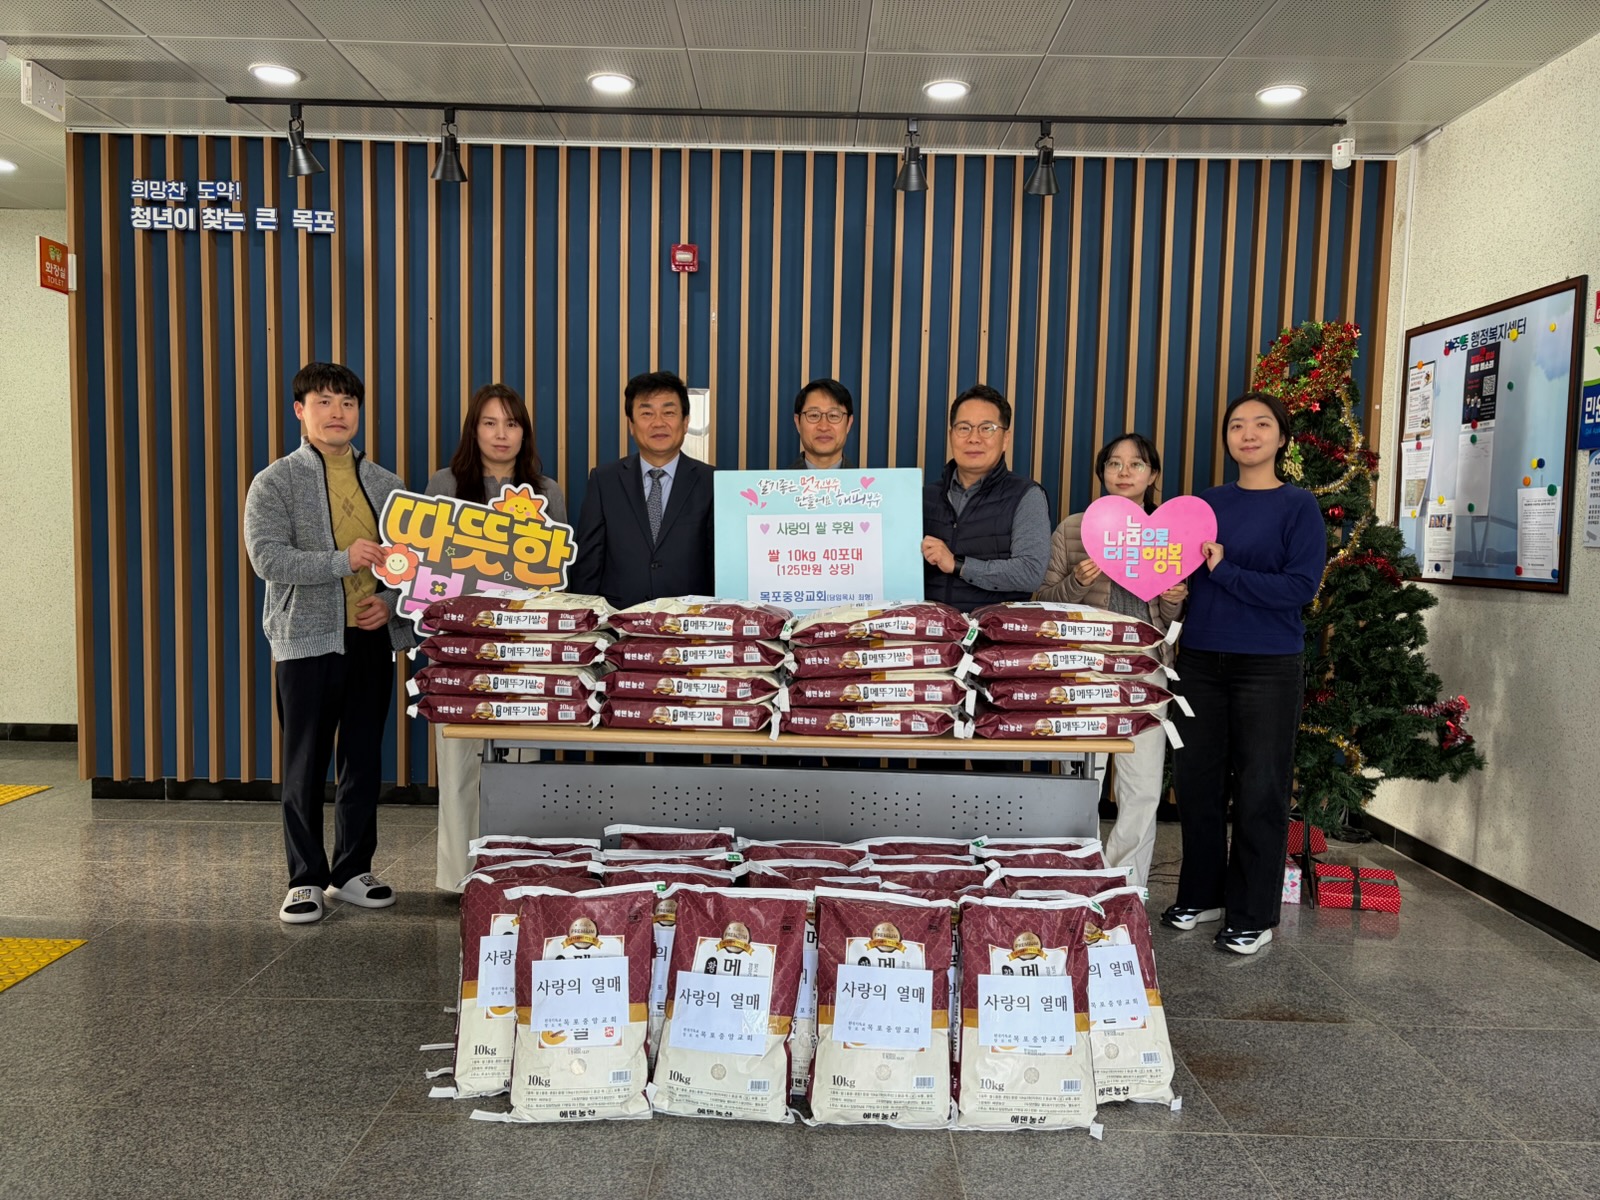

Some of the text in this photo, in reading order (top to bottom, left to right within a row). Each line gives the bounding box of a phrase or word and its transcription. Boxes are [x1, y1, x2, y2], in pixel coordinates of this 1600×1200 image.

[131, 180, 241, 201] 희망찬 도약!
[131, 207, 336, 233] 청년이 찾는 큰 목포
[45, 262, 66, 279] 화장실
[47, 276, 64, 287] TOILET
[1471, 317, 1527, 347] 행정복지센터
[758, 478, 798, 495] 살기좋은
[795, 495, 832, 509] 만들어요
[777, 521, 854, 536] 사랑의 쌀 후원
[1104, 515, 1169, 546] 나눔으로
[387, 496, 571, 585] 따뜻한
[768, 548, 863, 562] 쌀 10kg 40포대
[1142, 543, 1182, 575] 행복
[690, 620, 727, 632] 메뚜기쌀
[1067, 625, 1106, 637] 메뚜기쌀
[507, 645, 545, 657] 메뚜기쌀
[689, 649, 727, 660] 메뚜기쌀
[868, 652, 908, 663] 메뚜기쌀
[499, 678, 538, 690] 메뚜기쌀
[683, 682, 721, 694] 메뚜기쌀
[869, 687, 908, 698] 메뚜기쌀
[1076, 688, 1113, 698] 메뚜기쌀
[502, 705, 540, 717] 메뚜기쌀
[679, 710, 716, 722] 메뚜기쌀
[855, 716, 895, 727] 메뚜기쌀
[1062, 721, 1100, 732] 메뚜기쌀
[484, 950, 515, 966] 사랑
[1109, 960, 1135, 977] 열매
[536, 976, 621, 996] 사랑의 열매
[842, 981, 925, 1004] 사랑의 열매
[679, 988, 720, 1009] 사랑의
[730, 993, 760, 1011] 열매
[984, 994, 1068, 1013] 사랑의 열매
[473, 1044, 497, 1056] 10kg
[527, 1074, 551, 1088] 10kg
[669, 1069, 691, 1085] 10kg
[832, 1075, 856, 1089] 10kg
[979, 1078, 1005, 1092] 10kg
[1098, 1086, 1130, 1096] 에덴농산
[559, 1109, 597, 1119] 에덴농산
[697, 1107, 733, 1118] 에덴농산
[862, 1112, 899, 1121] 에덴농산
[1010, 1115, 1047, 1124] 에덴농산
